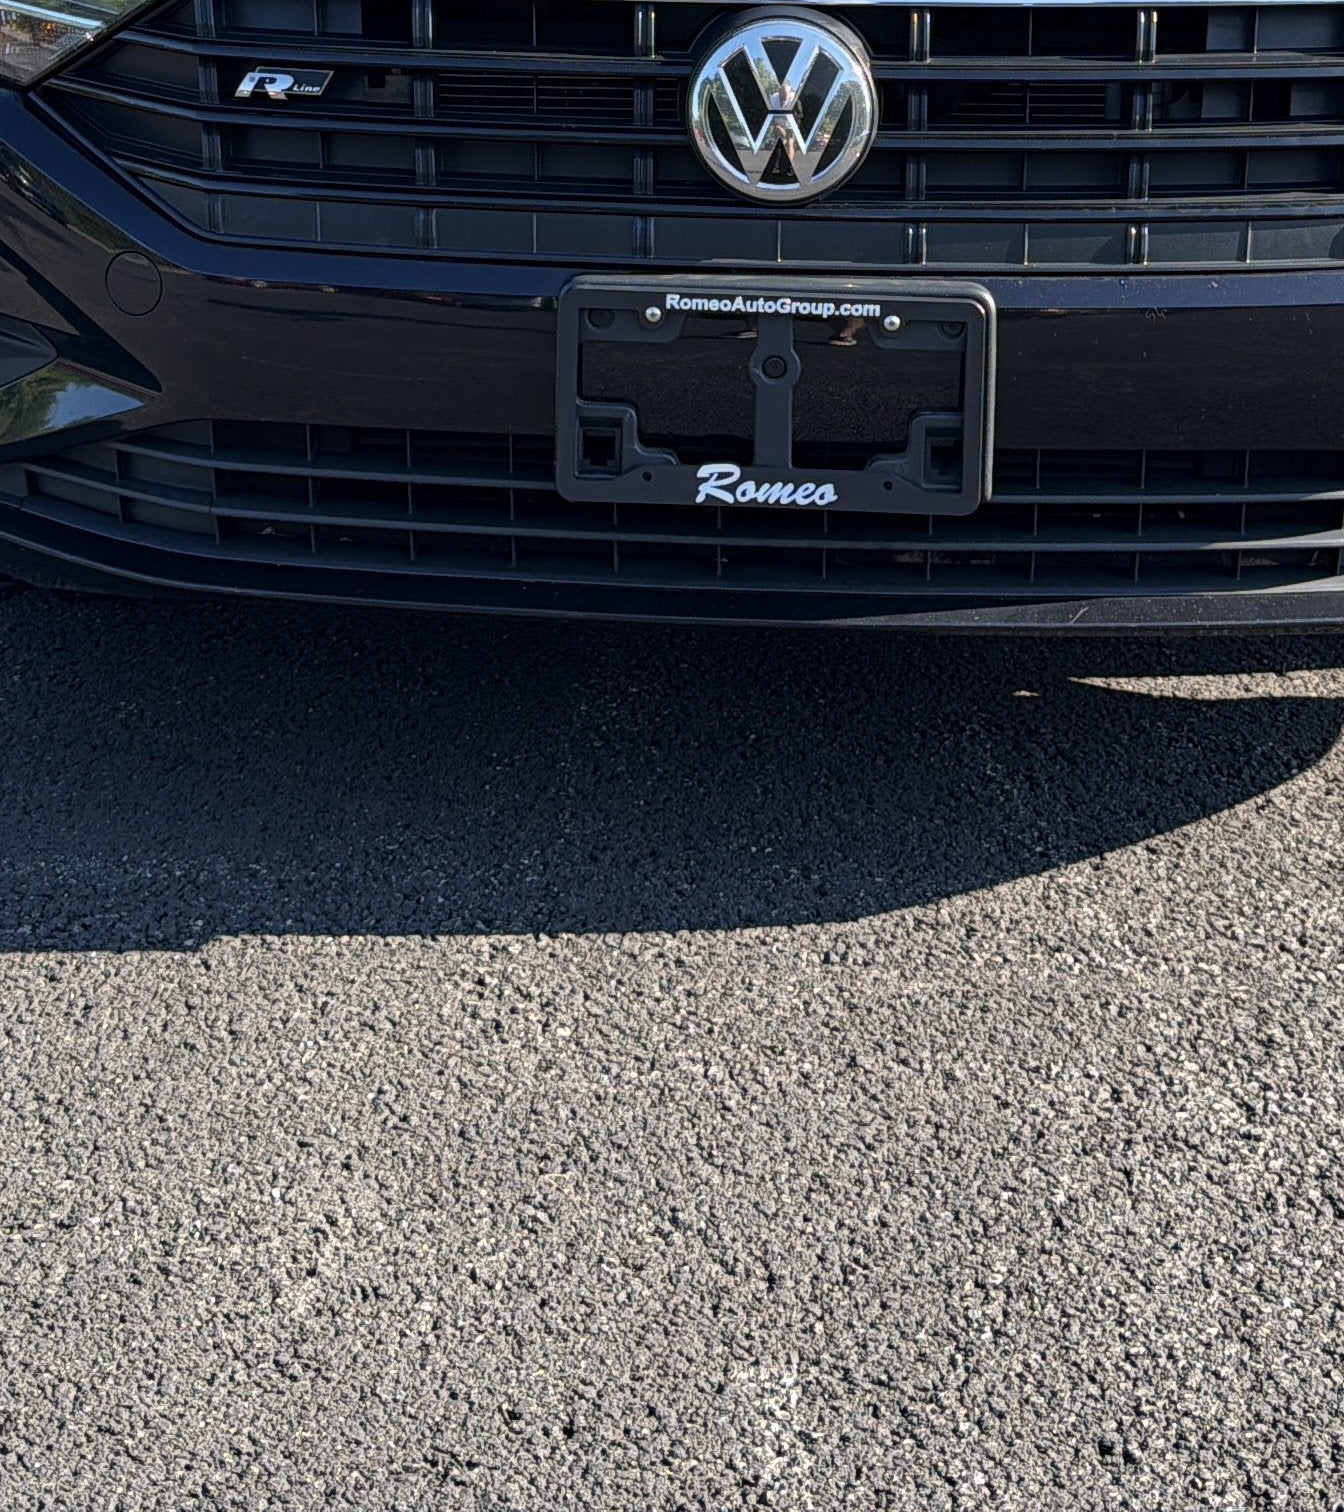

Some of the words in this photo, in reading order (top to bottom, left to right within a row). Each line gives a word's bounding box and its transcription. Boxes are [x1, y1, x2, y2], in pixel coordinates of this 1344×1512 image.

[234, 72, 294, 100] R
[694, 21, 870, 200] VW
[666, 294, 881, 318] RomeoAutoGroup.com
[695, 463, 838, 506] Romeo
